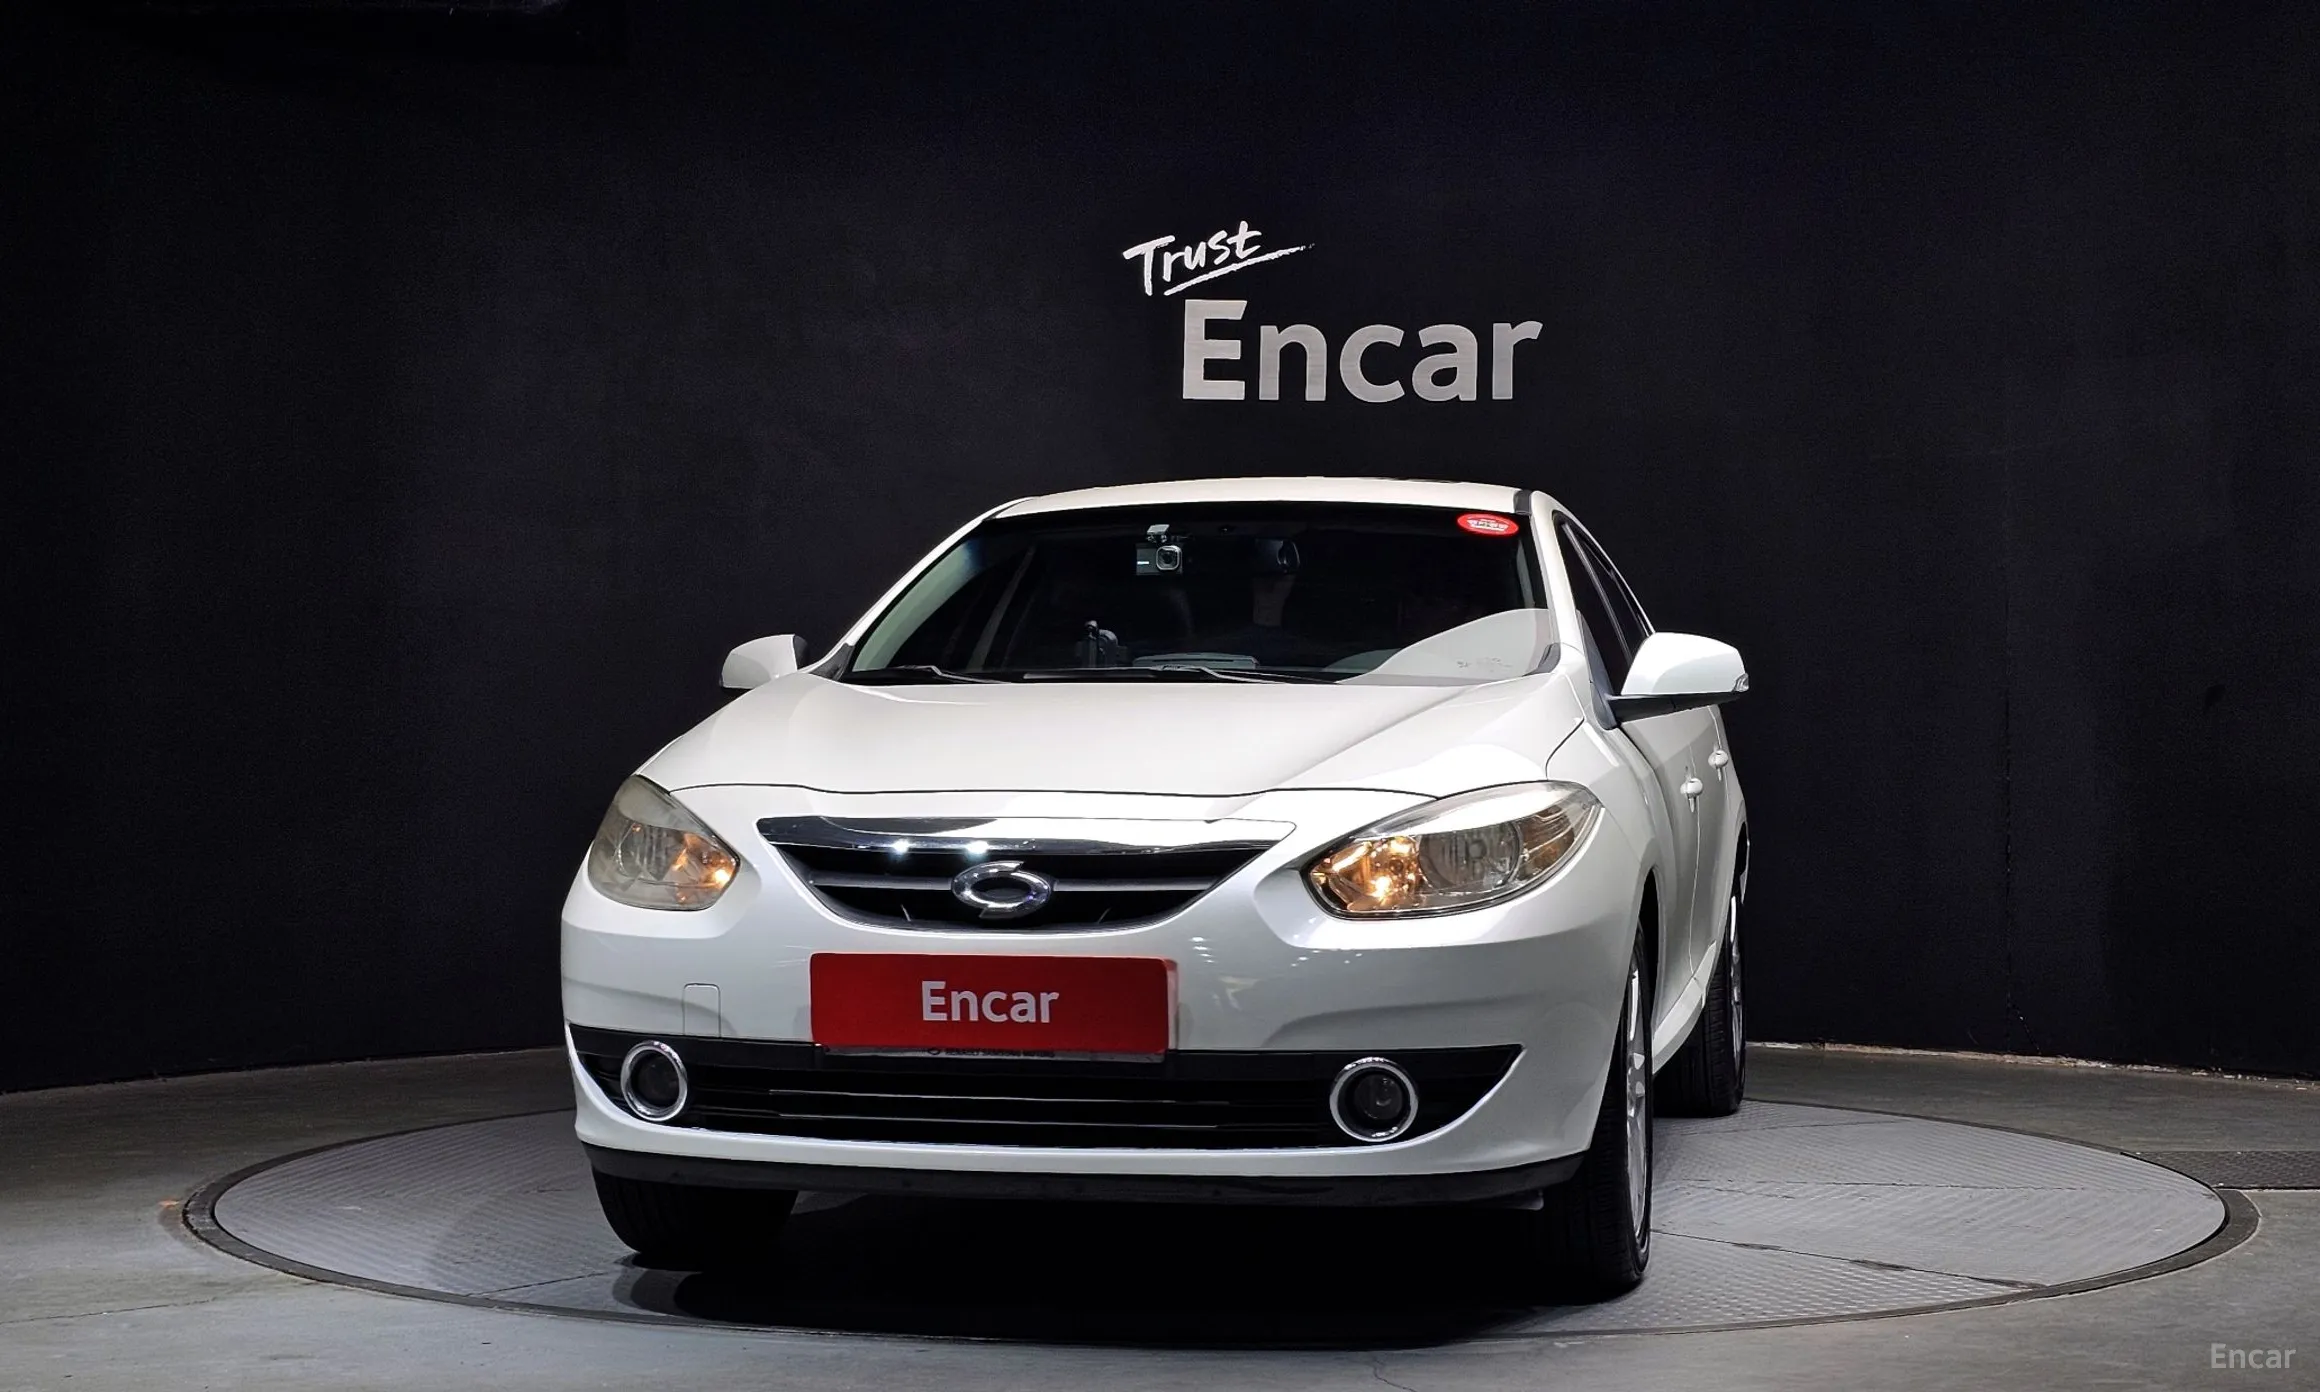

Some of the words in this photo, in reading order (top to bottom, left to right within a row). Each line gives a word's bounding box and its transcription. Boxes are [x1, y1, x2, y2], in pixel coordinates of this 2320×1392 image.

[1122, 220, 1263, 297] Trust
[1182, 298, 1544, 404] Encar
[921, 980, 1060, 1024] Encar
